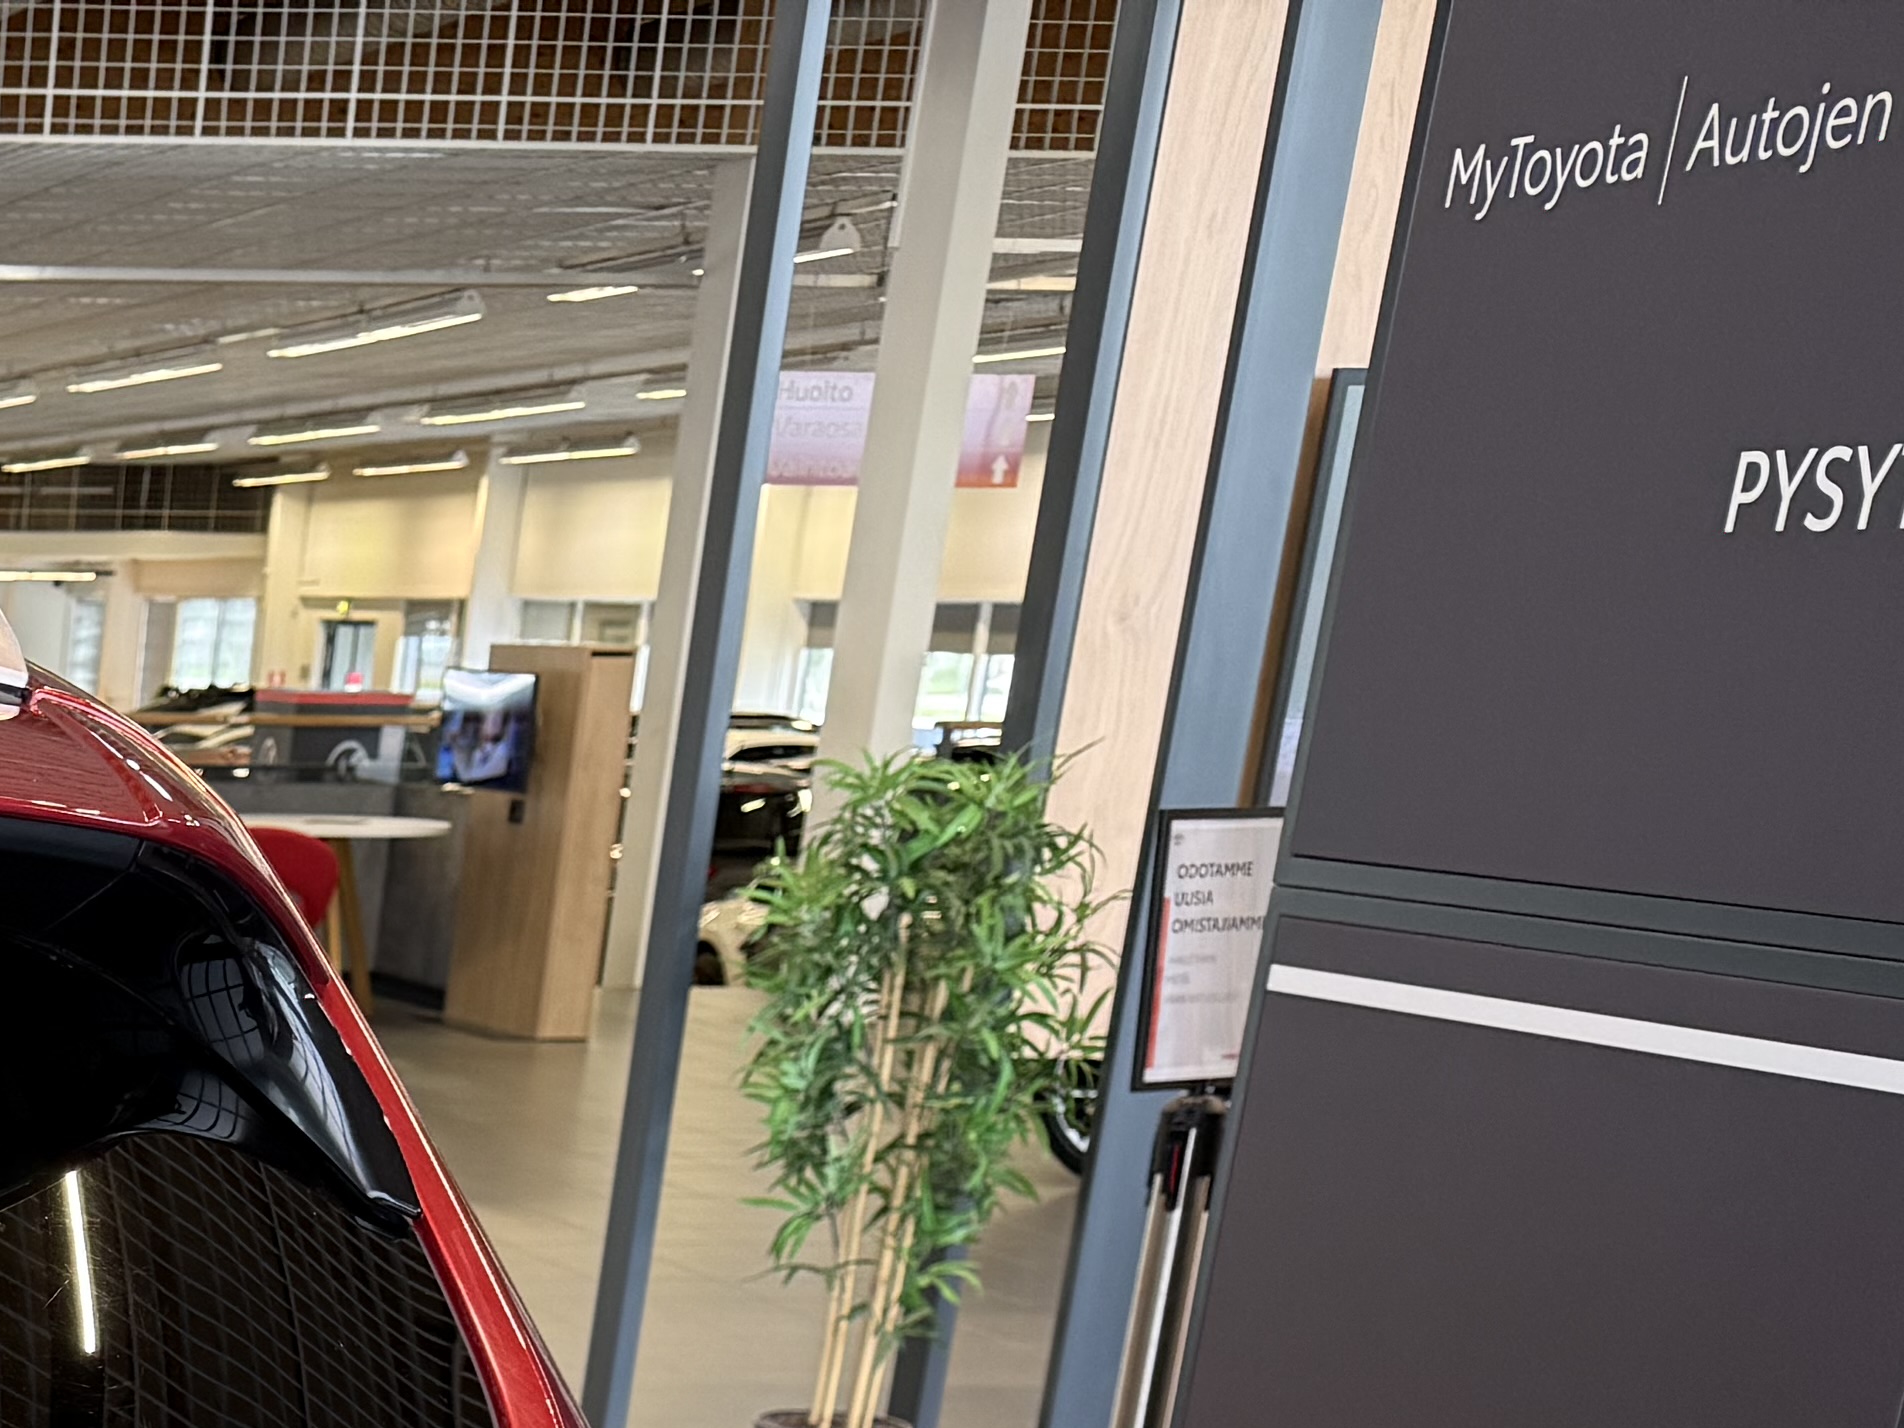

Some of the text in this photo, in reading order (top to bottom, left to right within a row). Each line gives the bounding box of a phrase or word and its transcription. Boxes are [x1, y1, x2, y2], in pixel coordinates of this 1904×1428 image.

[1445, 82, 1892, 221] MyToyota Autojen
[1723, 442, 1904, 534] PYSY
[1177, 860, 1254, 879] ODOTAMME
[1173, 889, 1214, 907] UUSIA
